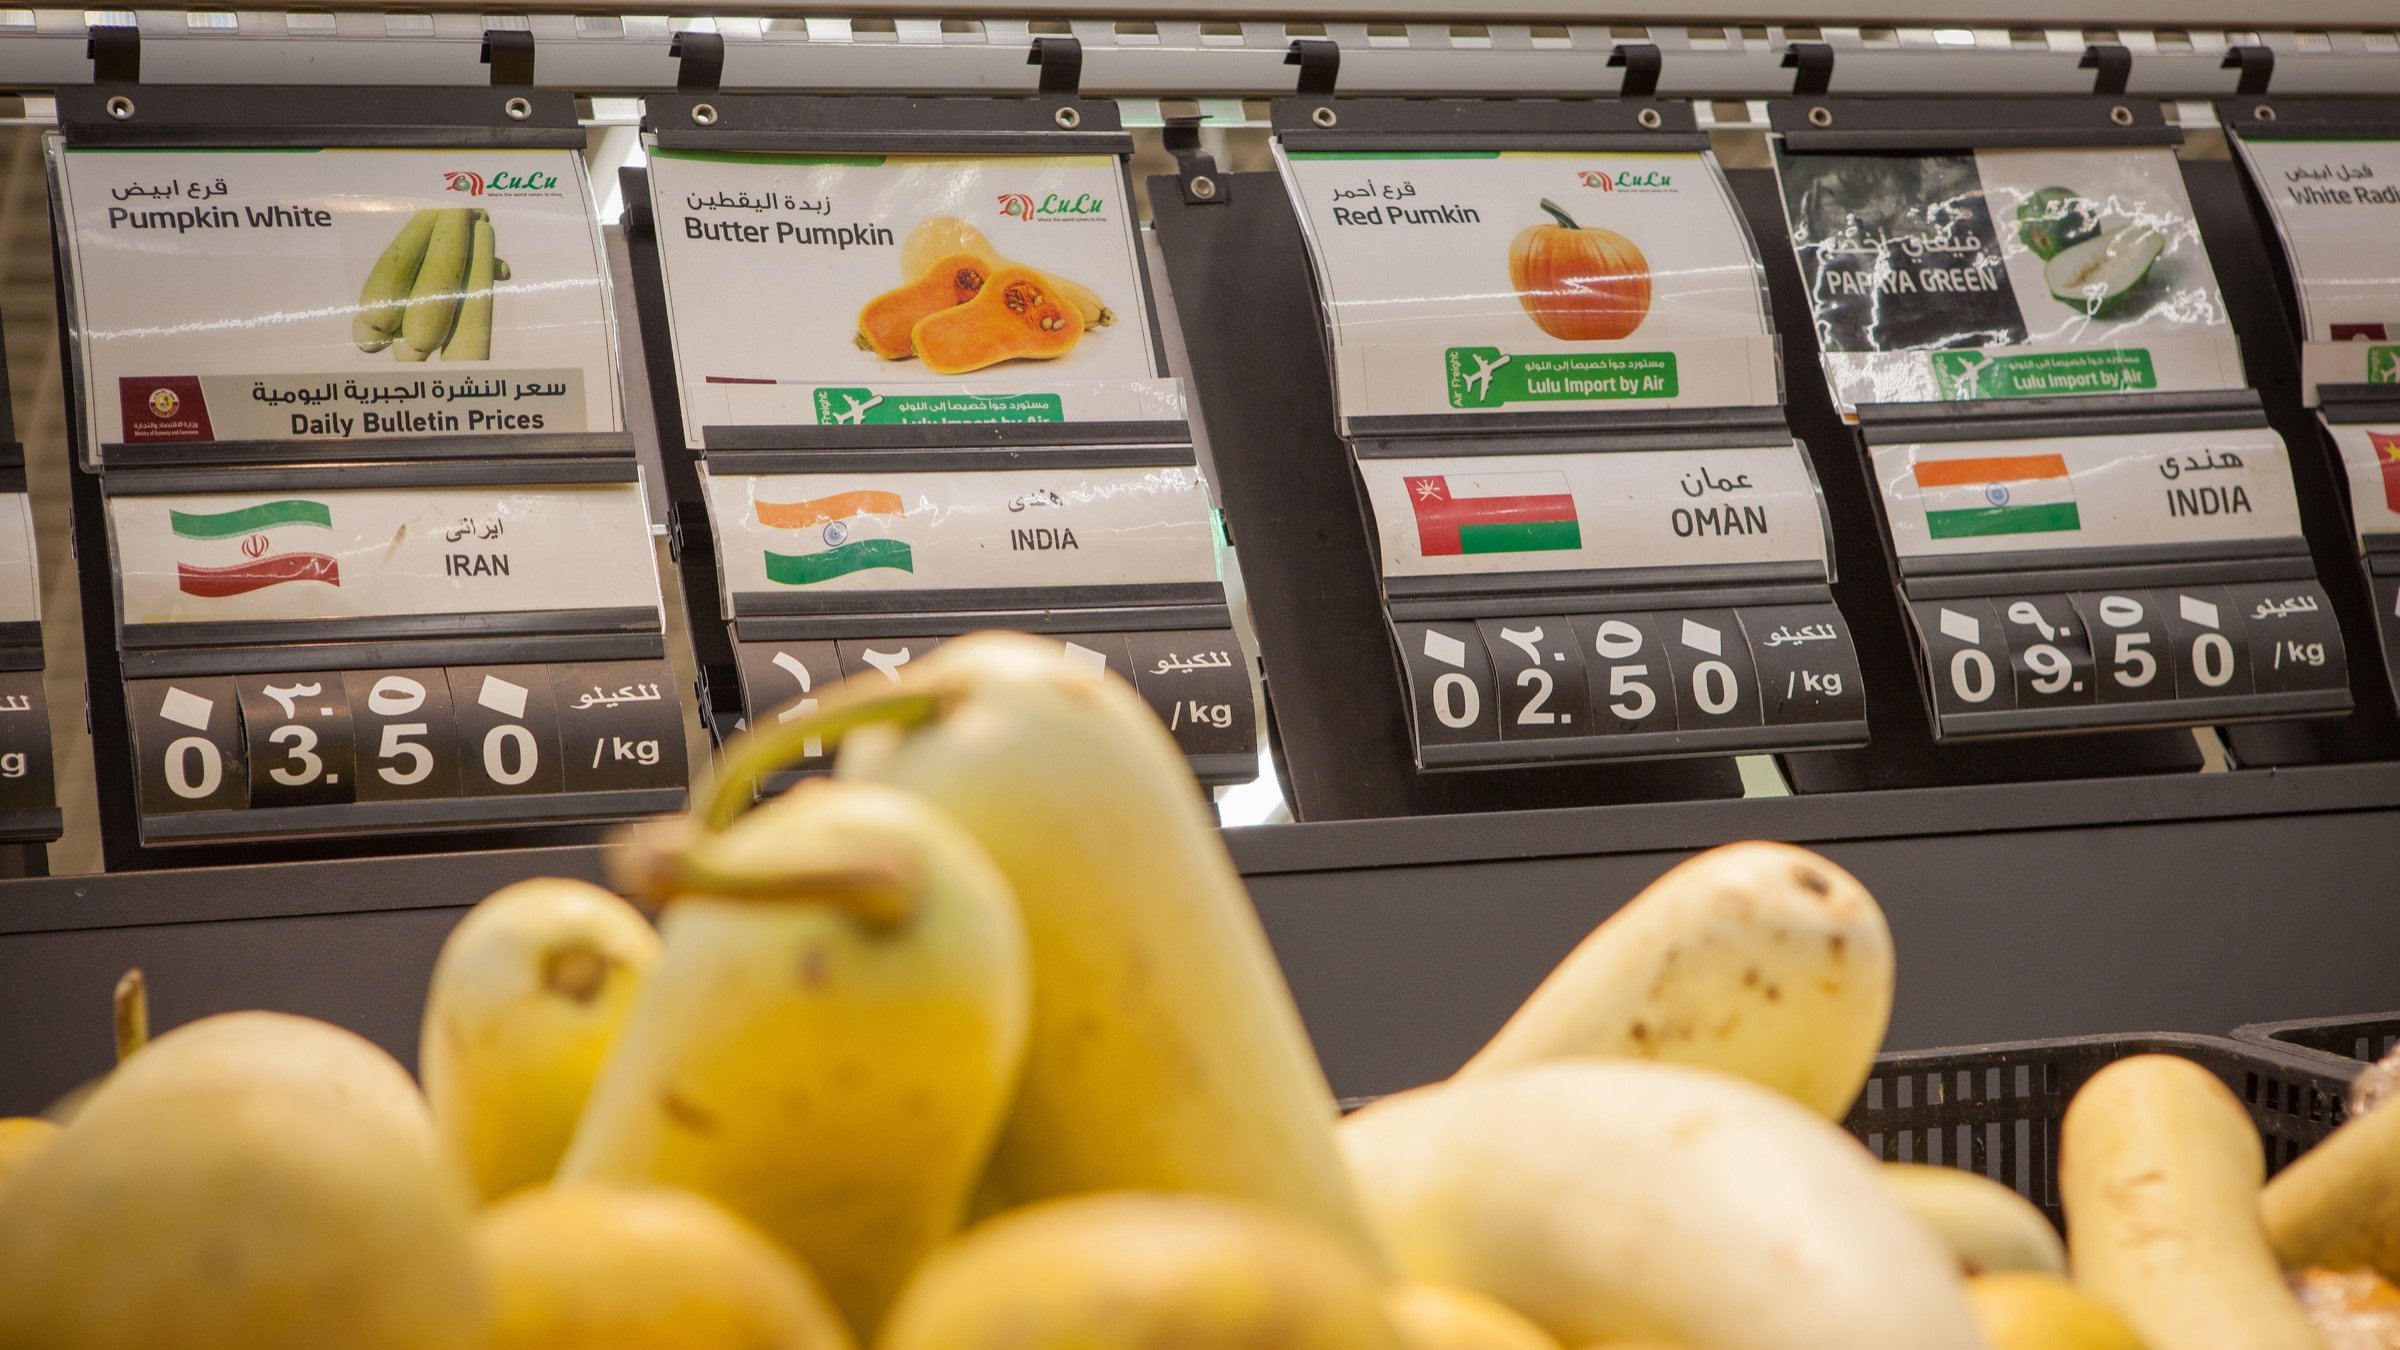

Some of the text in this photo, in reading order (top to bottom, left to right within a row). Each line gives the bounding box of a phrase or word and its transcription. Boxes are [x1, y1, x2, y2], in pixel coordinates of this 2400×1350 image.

[111, 178, 228, 201] قرع ابيض
[486, 172, 557, 190] LuLu
[1332, 179, 1416, 201] قرع أحمر
[1614, 171, 1671, 187] LuLu
[686, 192, 831, 216] زبدة اليقطين
[1037, 193, 1103, 214] LuLu
[2287, 185, 2353, 205] White
[108, 205, 332, 233] Pumpkin White
[1332, 204, 1480, 225] Red Pumkin
[685, 217, 894, 250] Butter Pumpkin
[1919, 268, 1999, 292] GREEN
[252, 376, 567, 406] سعر النشرة الجبرية اليومية
[1449, 351, 1463, 407] Air Freight
[1527, 374, 1665, 395] Lulu Import by Air
[2013, 368, 2142, 390] Lulu Import by Air
[291, 409, 545, 437] Daily Bulletin Prices
[1680, 466, 1753, 498] عمان
[2166, 484, 2252, 517] INDIA
[1672, 505, 1768, 538] OMAN
[1010, 527, 1079, 551] INDIA
[445, 554, 510, 576] IRAN
[2250, 595, 2319, 620] للكيلو
[1764, 623, 1837, 647] للكيلو
[1149, 651, 1231, 676] للكيلو
[570, 682, 662, 710] للكيلو
